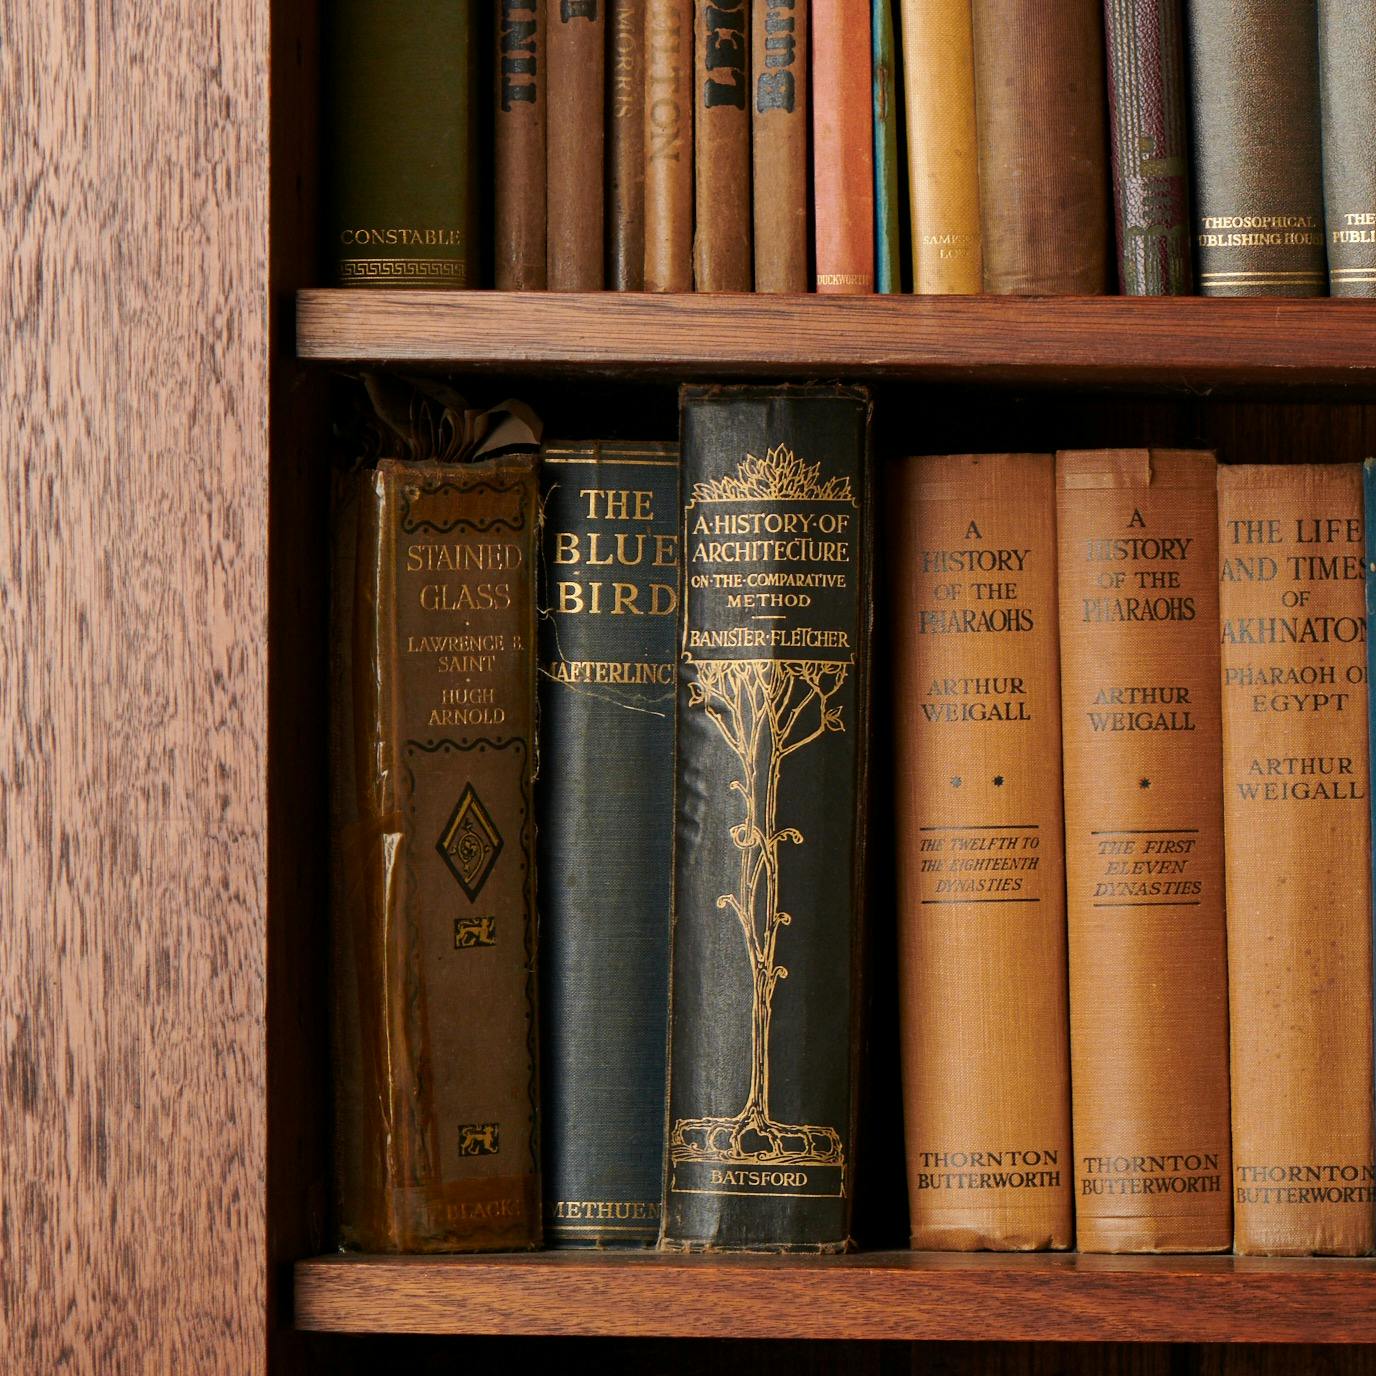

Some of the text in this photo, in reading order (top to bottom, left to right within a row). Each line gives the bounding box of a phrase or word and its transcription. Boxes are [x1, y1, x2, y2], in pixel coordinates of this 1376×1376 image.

[1202, 216, 1316, 230] THEOSOPHICAL
[341, 229, 461, 246] CONSTABLE
[817, 273, 870, 286] DUCKWORTH
[580, 489, 654, 520] THE
[1295, 519, 1361, 543] LIFE
[554, 532, 678, 565] BLUE
[692, 541, 850, 563] ARCHITECTURE
[407, 544, 521, 571] STAINED
[921, 550, 1031, 573] HISTORY
[419, 584, 511, 611] GLASS
[556, 582, 677, 616] BIRD
[971, 583, 1017, 600] THE
[726, 594, 811, 607] METHOD
[919, 609, 1034, 634] PHARAOHS
[408, 635, 505, 652] LAWRENCE
[438, 657, 495, 672] SAINT
[927, 679, 1027, 695] ARTHUR
[441, 688, 494, 705] HUGH
[1252, 695, 1348, 712] EGYPT
[428, 709, 505, 725] ARNOLD
[922, 703, 1032, 722] WEIGALL
[951, 837, 1039, 851] TWELFTH TO
[1143, 841, 1195, 854] FIRST
[950, 857, 1039, 872] EIGHTEENTH
[1105, 860, 1187, 875] ELEVEN
[936, 878, 1022, 893] DYNASTIES
[920, 1151, 1059, 1168] THORNTON
[710, 1170, 808, 1187] BATSFORD
[918, 1170, 1061, 1190] BUTTERWORTH
